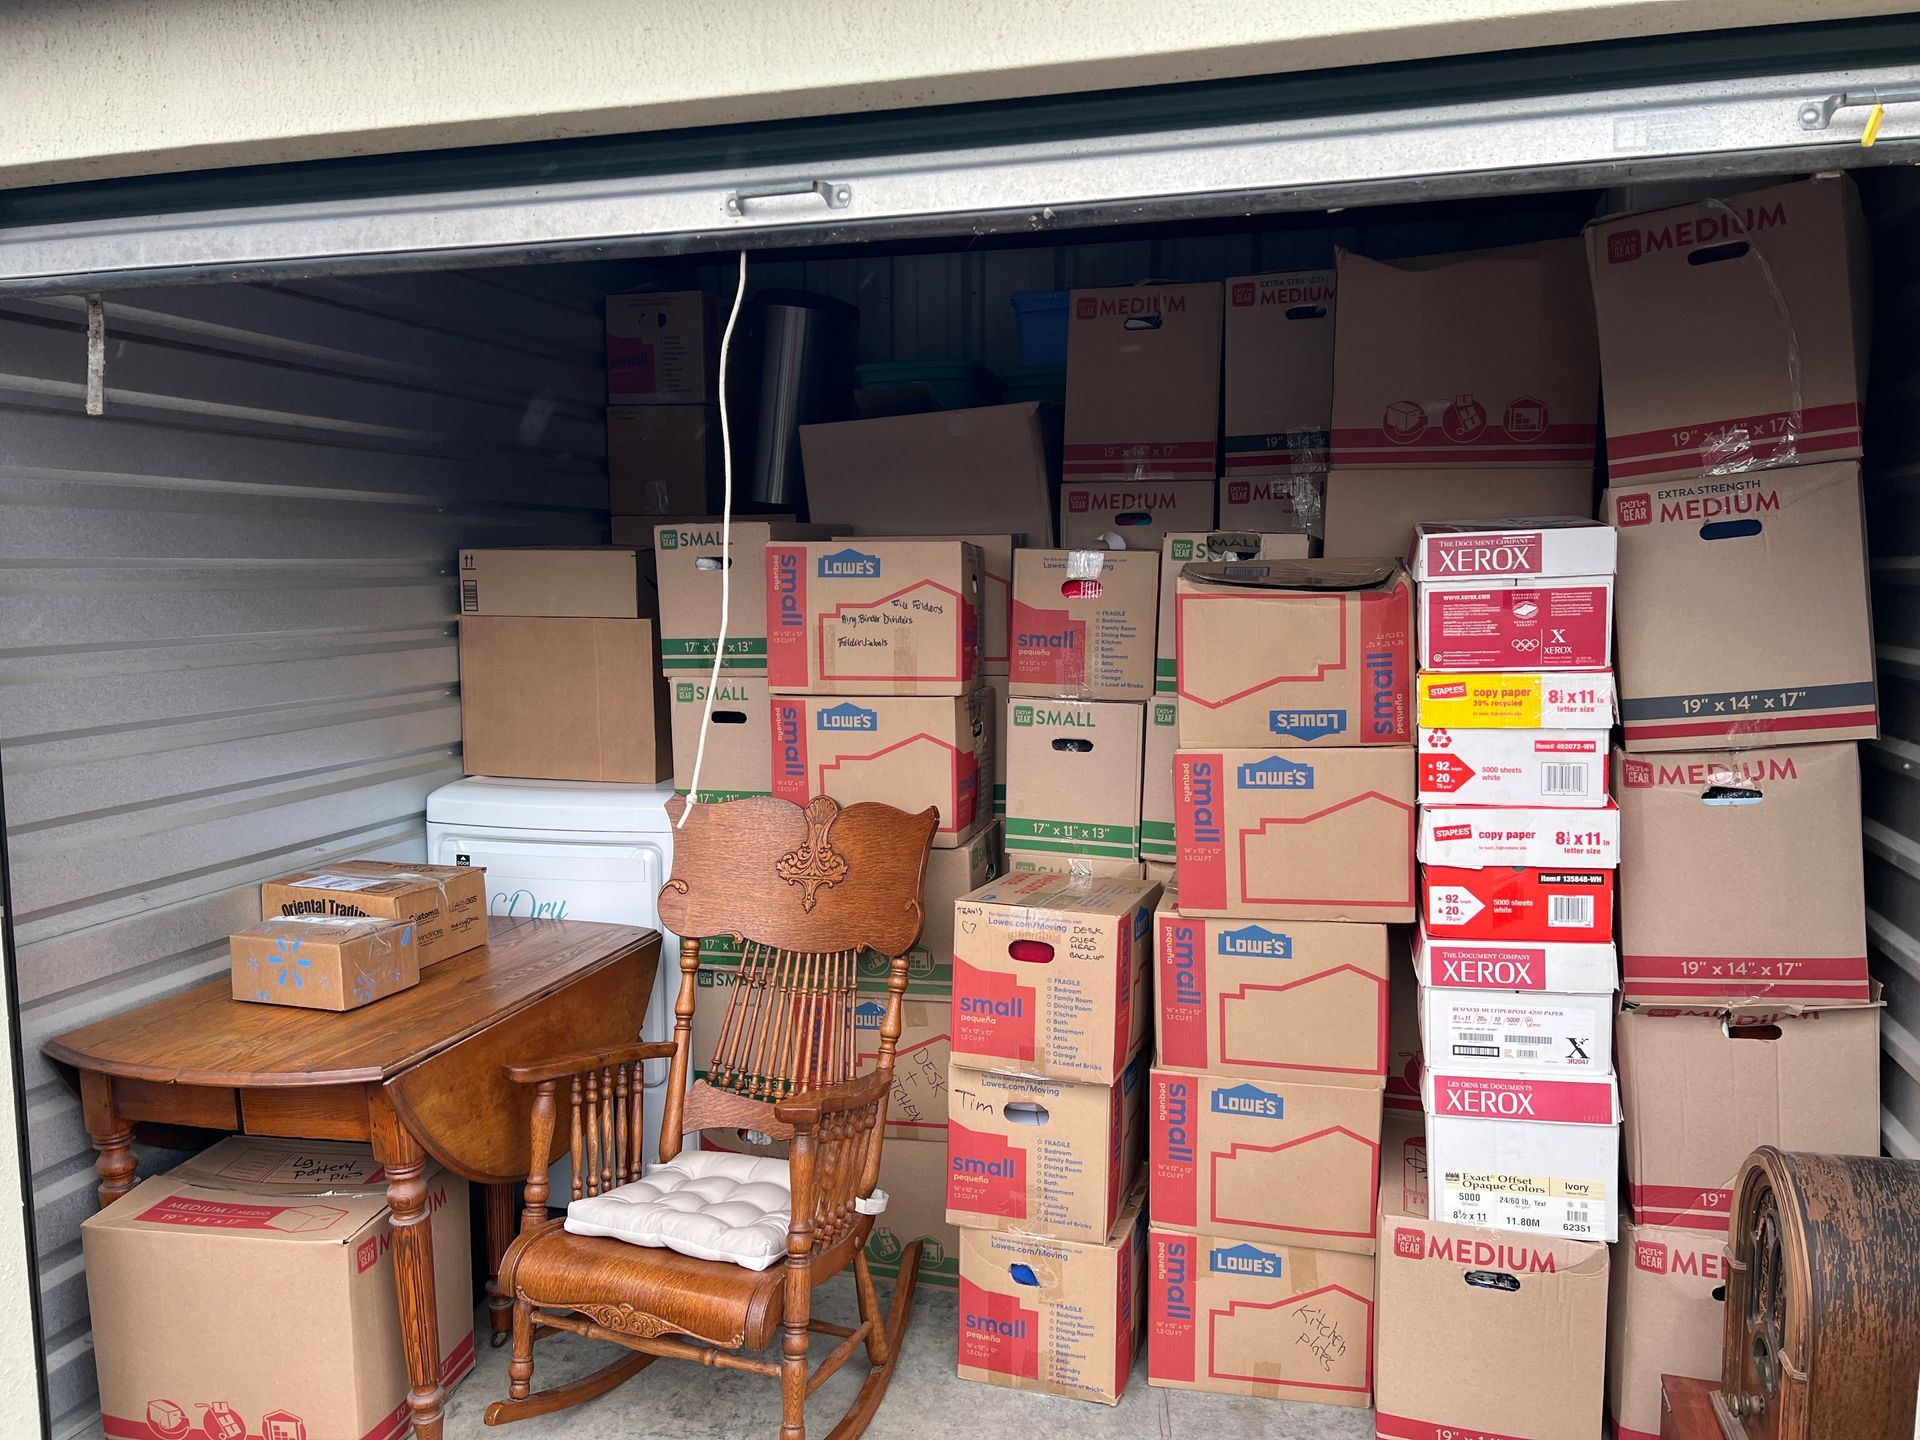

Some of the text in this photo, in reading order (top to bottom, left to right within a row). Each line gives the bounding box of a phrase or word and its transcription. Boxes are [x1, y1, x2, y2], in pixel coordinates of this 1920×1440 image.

[1645, 202, 1787, 253] MEDIUM
[1260, 285, 1335, 305] MEDIUM
[1100, 295, 1186, 317] MEDIUM
[1657, 479, 1761, 500] EXTRA STRENGTH
[1091, 493, 1176, 510] MEDIUM
[1660, 490, 1780, 523] MEDIUM
[1623, 508, 1647, 522] GEAR
[1455, 539, 1495, 547] DOCUMENT
[1496, 538, 1529, 546] COMPANY
[1439, 546, 1530, 573] XEROX
[824, 560, 874, 575] LOWE'S
[782, 554, 803, 626] small
[860, 613, 880, 624] Binder
[882, 613, 913, 625] Dividers
[1018, 631, 1075, 649] small
[1544, 646, 1572, 654] XEROX
[1367, 652, 1393, 734] small
[1430, 685, 1531, 699] STAPLES copy paper
[1567, 692, 1577, 704] x
[1579, 689, 1594, 704] 11
[1682, 691, 1806, 714] 19" x 14" x 17"
[823, 713, 872, 728] LOWE'S
[1036, 710, 1096, 728] SMALL
[783, 707, 804, 776] small
[1535, 742, 1555, 750] Item#
[1246, 768, 1306, 786] LOWE'S
[1482, 766, 1522, 774] 5000 sheets
[1658, 757, 1797, 785] MEDIUM
[1482, 774, 1501, 782] white
[1628, 772, 1650, 784] GEAR
[1193, 762, 1220, 843] small
[1033, 823, 1050, 834] 17"
[1063, 825, 1078, 836] 11"
[1092, 828, 1110, 839] 13"
[1435, 827, 1536, 841] STAPLES copy paper
[1574, 834, 1583, 845] x
[1586, 832, 1601, 846] 11
[1564, 847, 1584, 855] letter
[1541, 875, 1602, 883] Item# 135848-WH
[281, 899, 371, 918] Oriental Tradin
[1511, 899, 1533, 907] sheets
[1073, 926, 1104, 935] DESK
[1226, 936, 1285, 956] LOWE'S
[1069, 952, 1092, 960] BACK
[1442, 951, 1458, 959] THE
[1458, 952, 1497, 960] DOCUMENT
[1176, 927, 1201, 1005] small
[1442, 960, 1532, 985] XEROX
[1681, 961, 1803, 976] 19" x 14" x 17"
[960, 997, 1022, 1018] small
[961, 1014, 996, 1025] pequeña
[913, 1047, 948, 1098] DESK
[982, 1079, 1059, 1097] Lowes.com/Moving
[1490, 1083, 1532, 1091] DOCUMENTS
[955, 1089, 994, 1115] Tim
[1219, 1094, 1276, 1115] LOWE'S
[1446, 1089, 1535, 1115] XEROX
[1168, 1083, 1193, 1162] small
[1044, 1139, 1071, 1148] FRAGILE
[1044, 1148, 1072, 1156] Bedroom
[952, 1156, 1014, 1179] small
[1044, 1156, 1083, 1166] Family Room
[295, 1160, 357, 1179] Pottery
[1044, 1164, 1082, 1174] Dining Room
[1044, 1171, 1067, 1180] Kitchen
[953, 1174, 989, 1184] pequeña
[1498, 1175, 1532, 1185] Offset
[1044, 1187, 1074, 1196] Basement
[1462, 1181, 1546, 1193] Opaque Colors
[1565, 1182, 1589, 1192] Ivory
[1459, 1192, 1481, 1201] 5000
[1499, 1196, 1519, 1205] 24/60
[1521, 1197, 1531, 1206] lb.
[1700, 1193, 1726, 1207] 19"
[168, 1202, 227, 1215] MEDIUM
[1044, 1203, 1069, 1211] Laundry
[1044, 1210, 1067, 1218] Garage
[1477, 1212, 1487, 1221] 11
[1506, 1217, 1540, 1227] 11.80M
[1073, 1222, 1092, 1230] Bricks
[1563, 1223, 1591, 1232] 62351
[1397, 1232, 1421, 1243] pen+
[991, 1241, 1069, 1262] Lowes.com/Moving
[1400, 1242, 1420, 1254] GEAR
[1428, 1235, 1556, 1274] MEDIUM
[1638, 1246, 1664, 1257] pen+
[1218, 1253, 1275, 1274] LOWE'S
[1640, 1256, 1663, 1270] GEAR
[1167, 1242, 1191, 1319] small
[966, 1314, 1025, 1339] small
[1292, 1305, 1346, 1356] Kitchen
[966, 1330, 1000, 1343] pequeña
